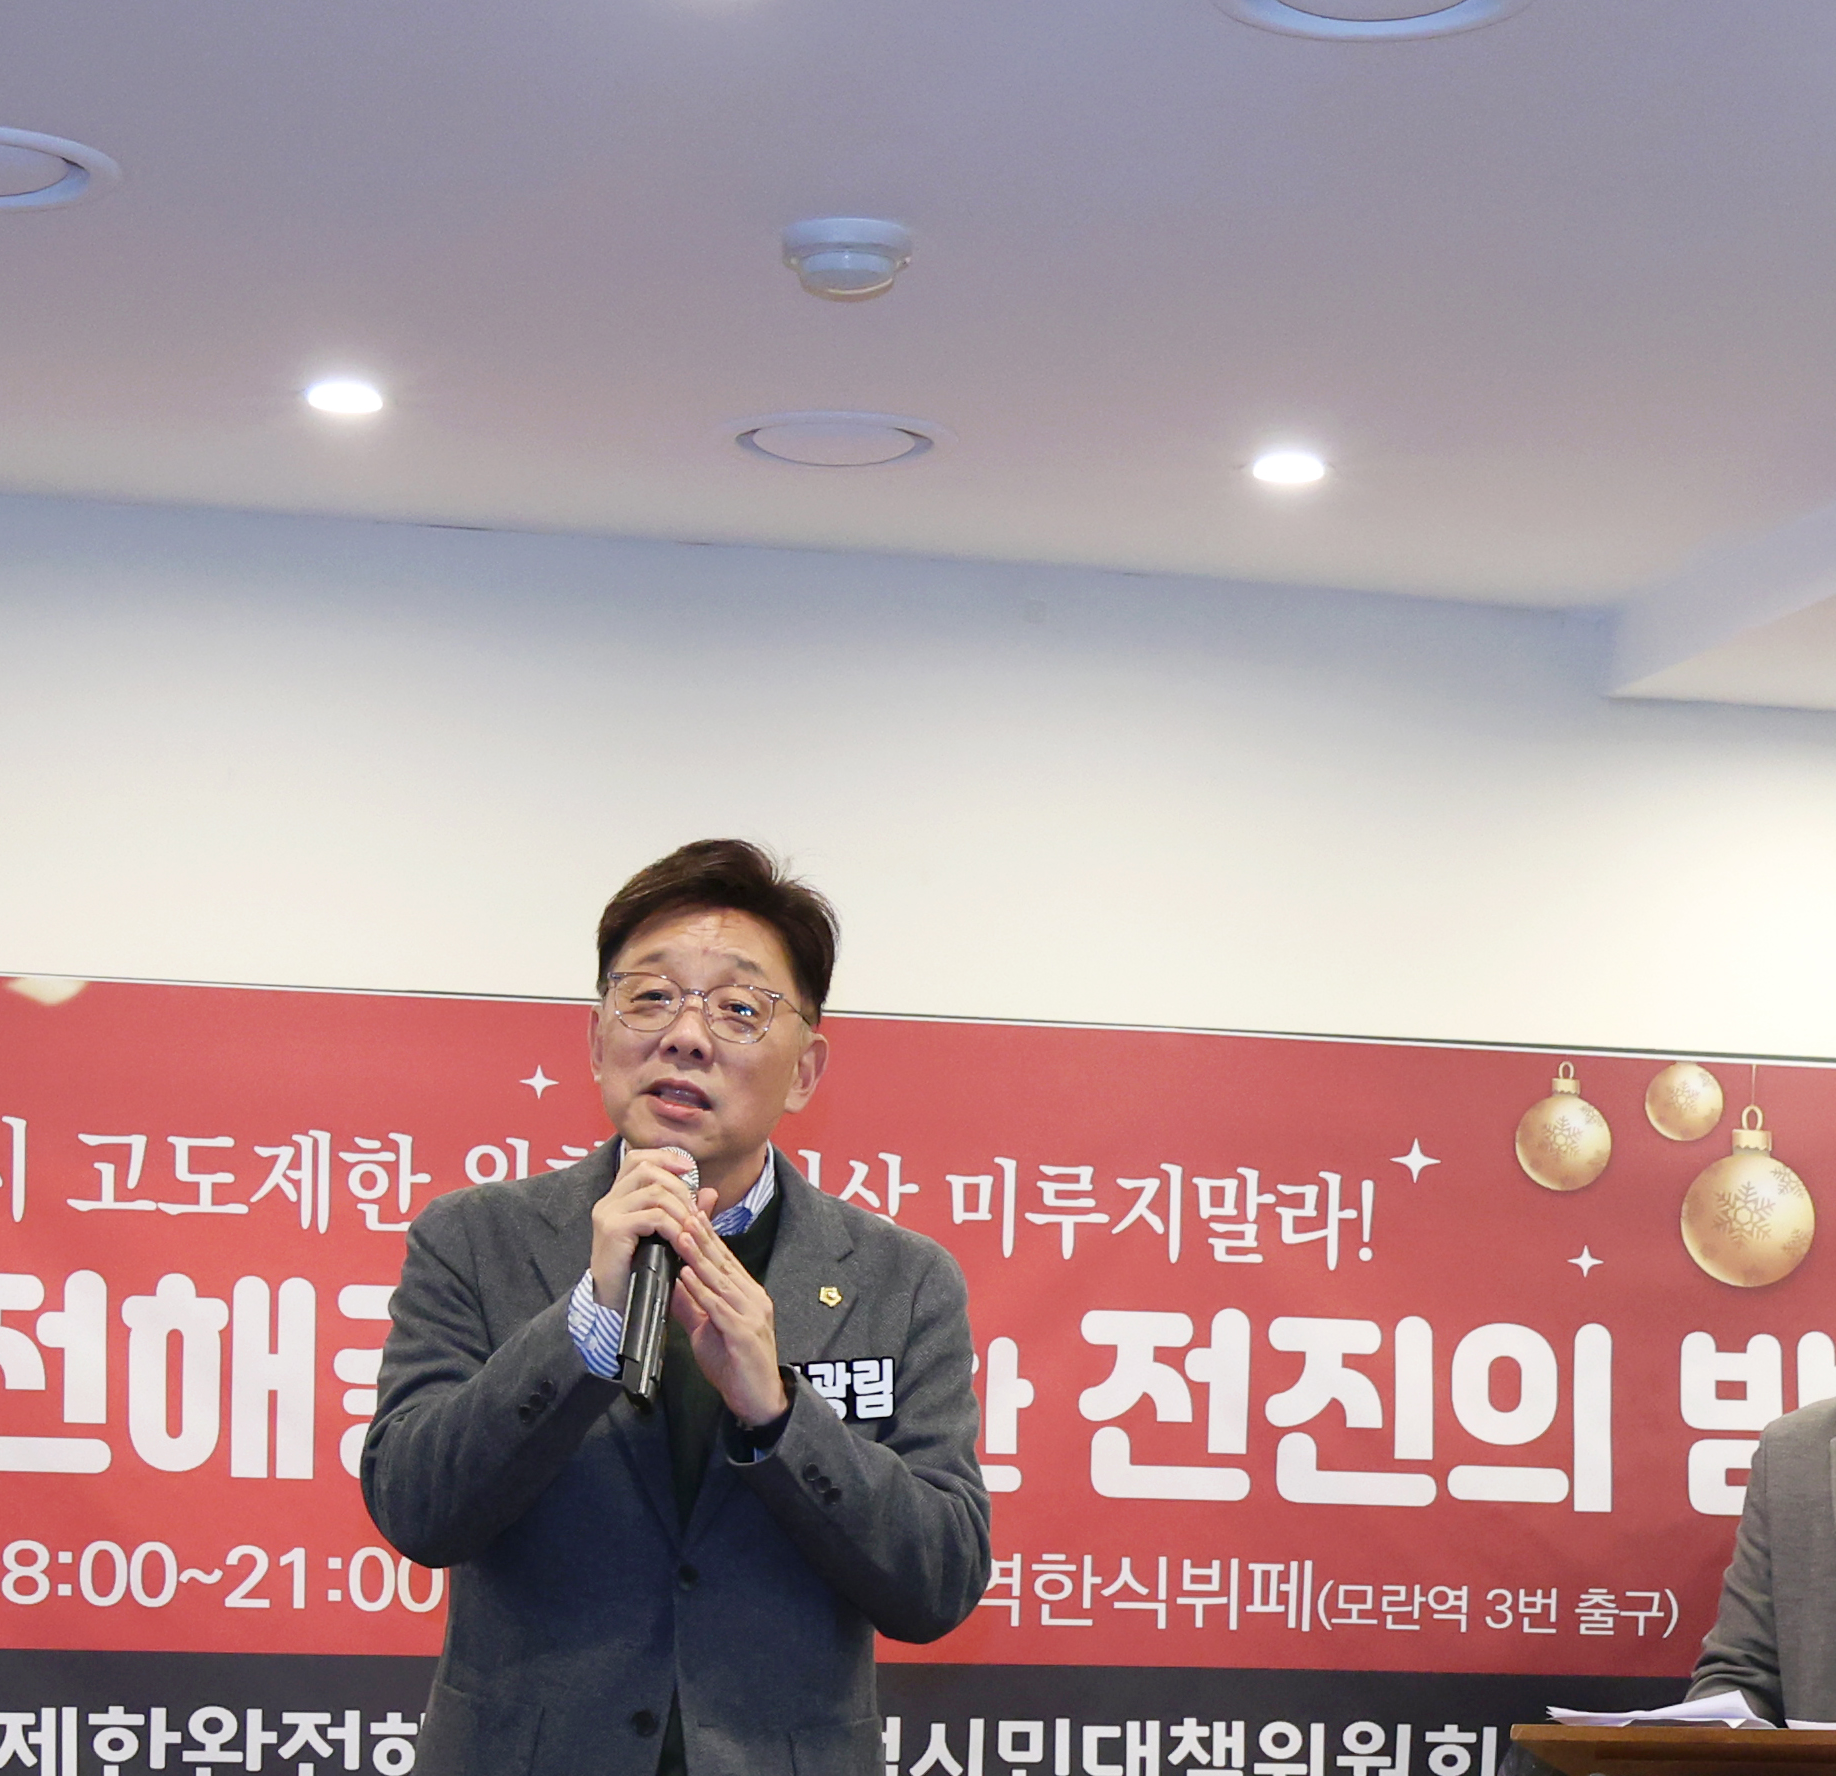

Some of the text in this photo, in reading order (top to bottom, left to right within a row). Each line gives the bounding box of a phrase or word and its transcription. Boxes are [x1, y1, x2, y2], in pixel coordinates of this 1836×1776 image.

[65, 1127, 433, 1235] 고도제한
[946, 1155, 1376, 1271] 미루지말라!
[796, 1356, 895, 1420] 광림
[1078, 1306, 1612, 1514] 전진의
[1484, 1587, 1558, 1634] 3번
[1574, 1588, 1679, 1639] 출구)
